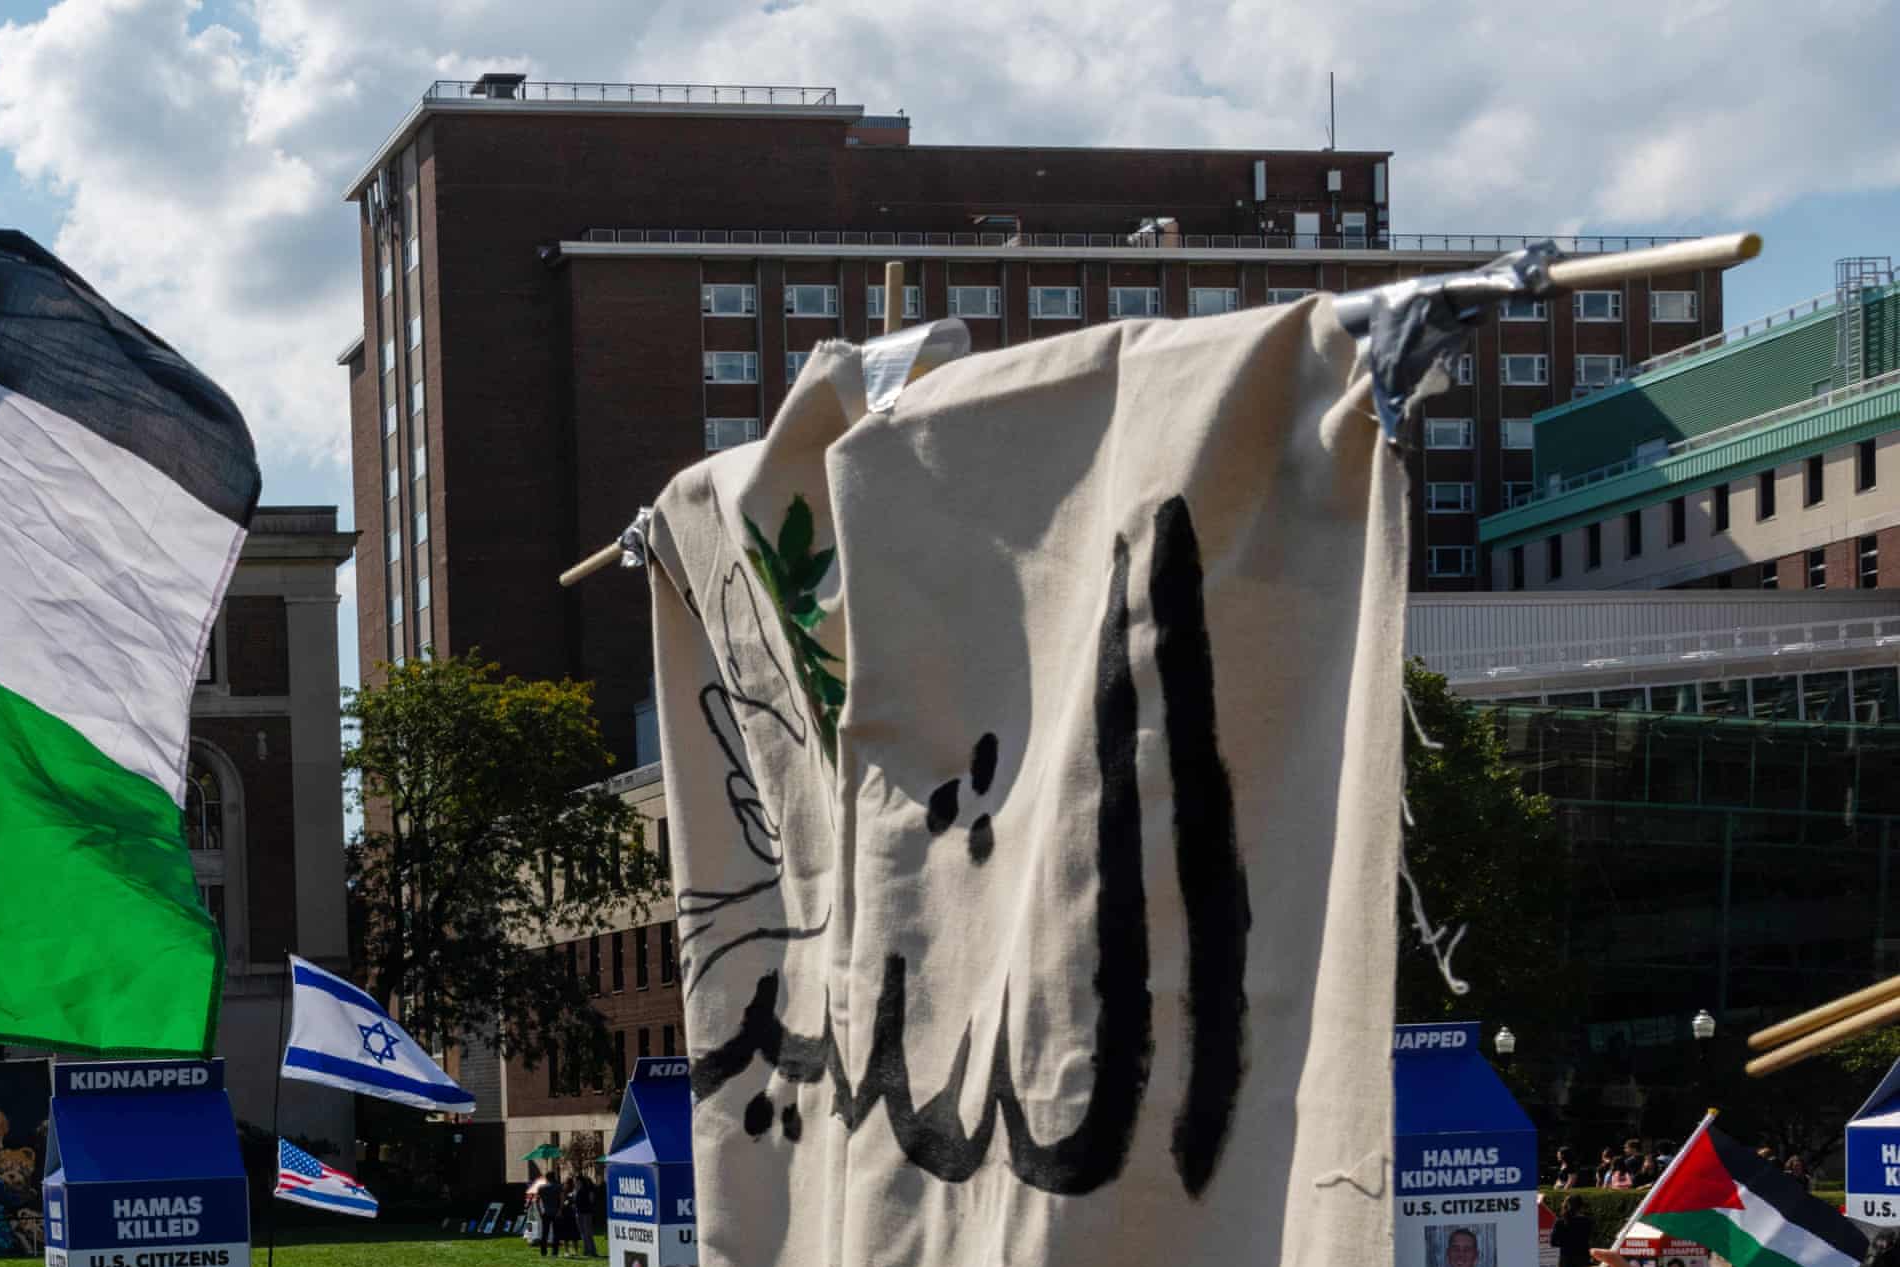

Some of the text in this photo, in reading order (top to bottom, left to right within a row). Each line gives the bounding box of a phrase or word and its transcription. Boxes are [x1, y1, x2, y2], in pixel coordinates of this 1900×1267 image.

[1396, 1030, 1468, 1050] APPED
[69, 1067, 209, 1091] KIDNAPPED
[1422, 1147, 1500, 1168] HAMAS
[618, 1176, 646, 1195] HAMAS
[1401, 1167, 1522, 1189] KIDNAPPED
[112, 1196, 203, 1218] HAMAS
[1404, 1198, 1521, 1217] U.S. CITIZENS
[1864, 1200, 1896, 1217] U.S.
[117, 1219, 200, 1241] KILLED
